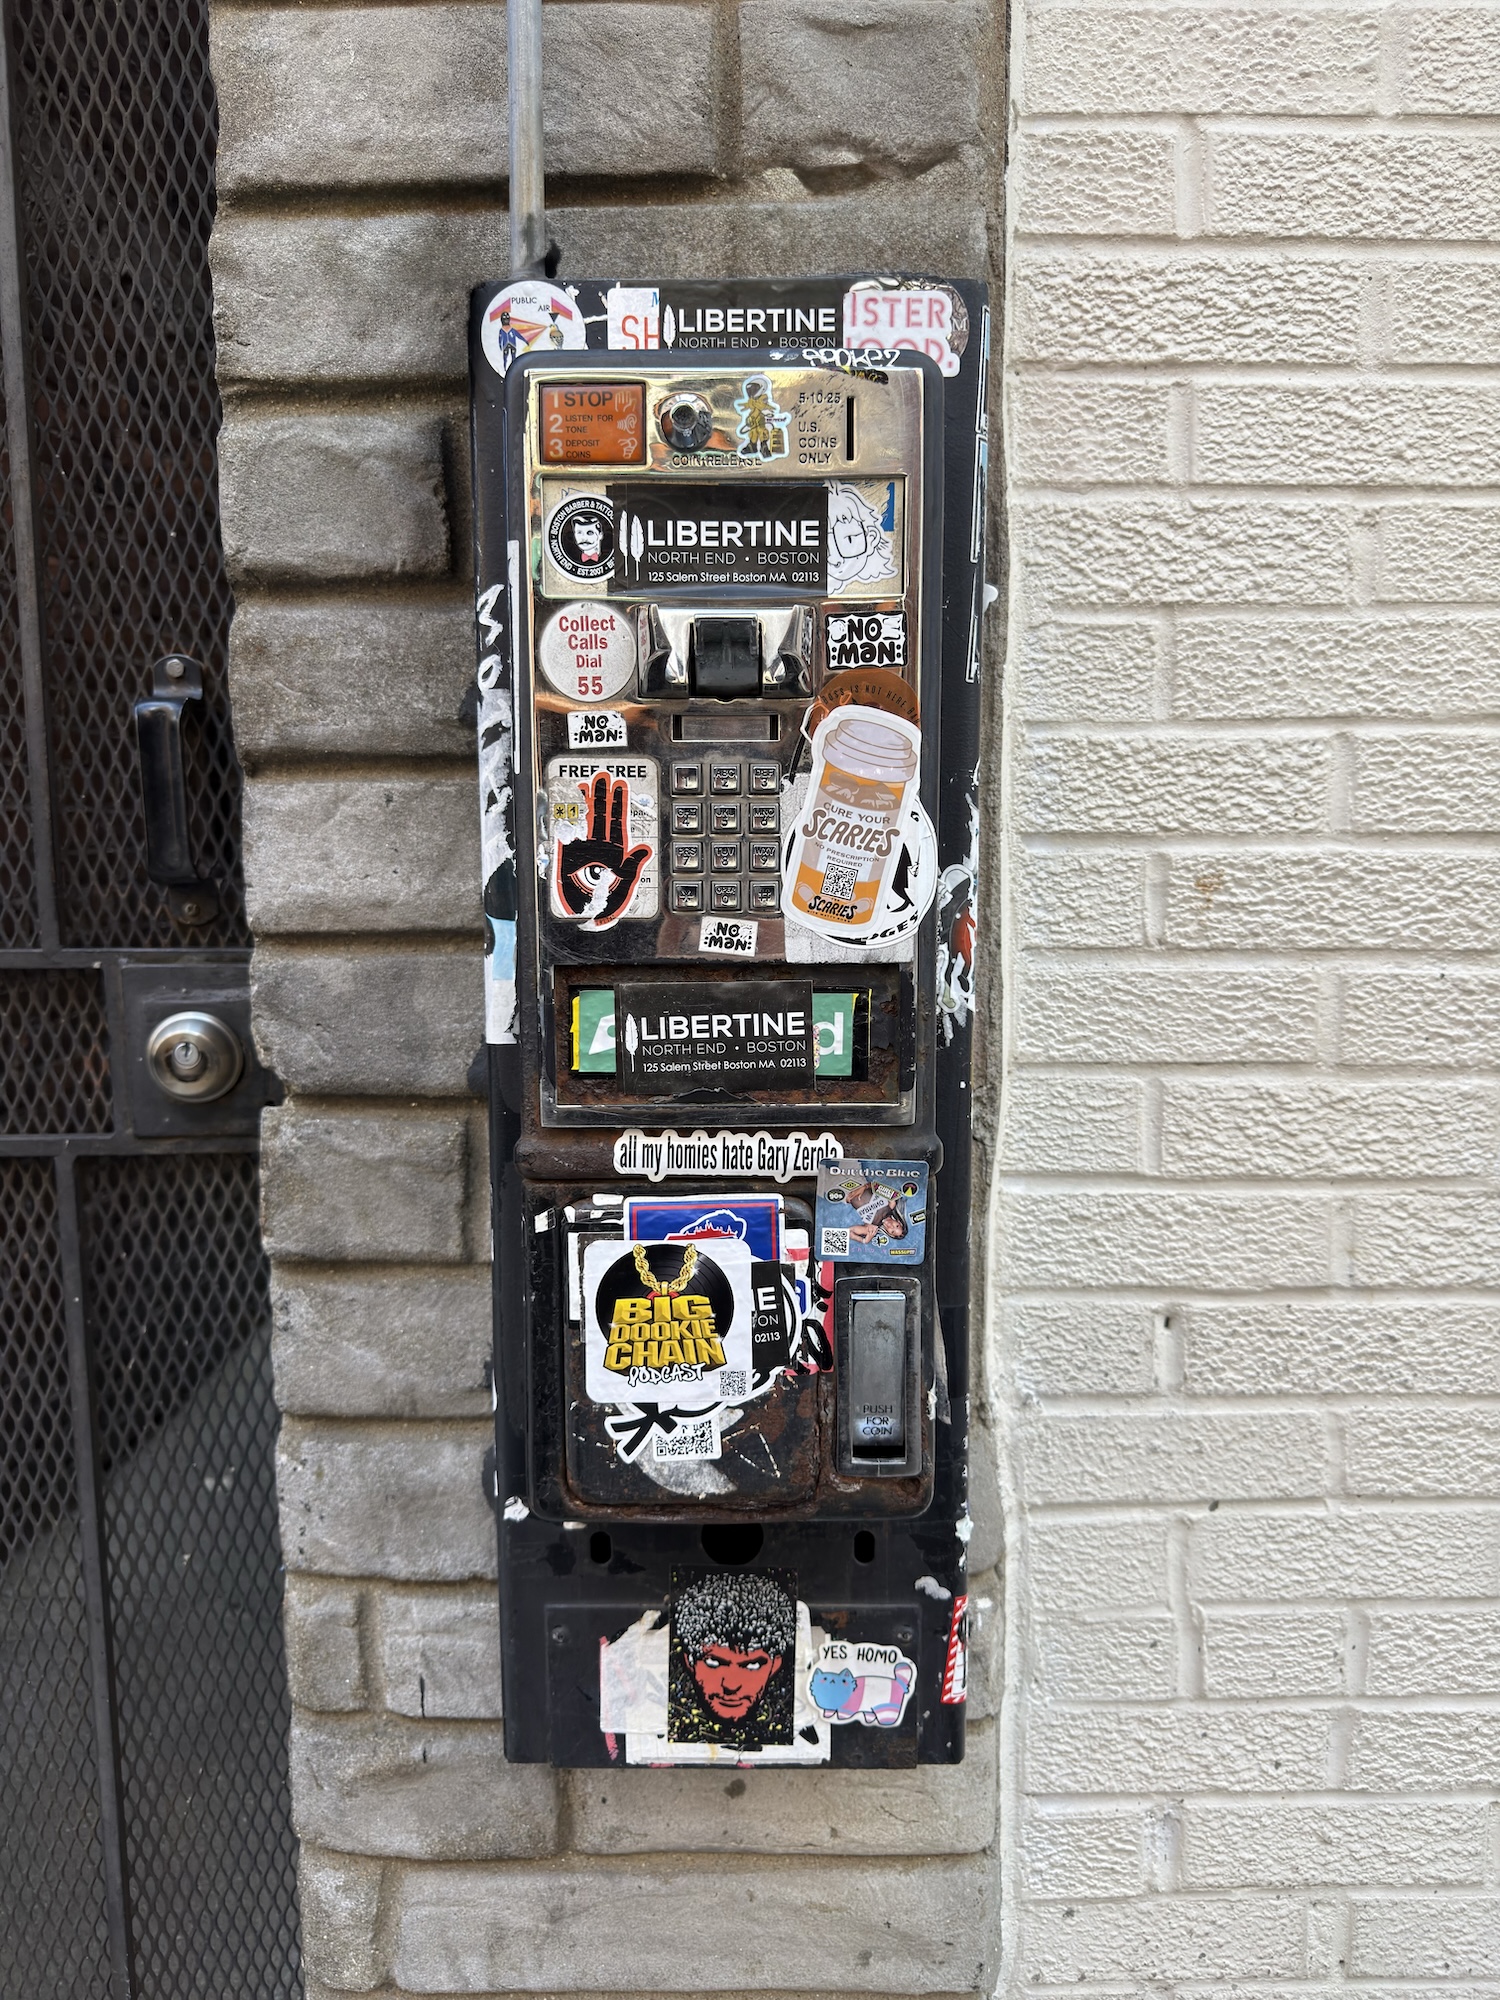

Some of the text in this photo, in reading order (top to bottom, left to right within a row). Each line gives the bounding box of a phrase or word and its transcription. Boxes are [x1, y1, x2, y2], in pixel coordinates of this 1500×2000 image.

[679, 308, 836, 333] LIBERTINE
[679, 337, 836, 348] NORTH END BOSTON
[551, 391, 613, 408] 1 STOP
[549, 414, 563, 433] 2
[798, 421, 821, 432] U.S.
[550, 439, 563, 458] 3
[799, 438, 836, 448] COINS
[672, 454, 762, 466] COIN RELEASE
[799, 453, 831, 464] ONLY
[551, 510, 567, 535] BOSTON
[564, 500, 590, 513] BARBER
[647, 520, 820, 547] LIBERTINE
[648, 552, 820, 564] NORTH END BOSTON
[648, 571, 820, 582] 125 Salem Street Boston MA 02113
[559, 615, 616, 632] Collect
[847, 618, 882, 642] NO
[568, 634, 608, 650] Calls
[576, 655, 602, 668] Dial
[578, 676, 603, 695] 55
[850, 685, 859, 693] IS
[865, 684, 882, 694] NOT
[584, 715, 609, 730] NO
[559, 766, 647, 778] FREE FREE
[823, 802, 891, 825] CURE YOUR
[815, 842, 880, 862] NO PRESCRIPTION
[826, 855, 863, 868] REQUIRED
[716, 922, 741, 938] NO
[641, 1012, 806, 1040] LIBERTINE
[642, 1040, 806, 1056] NORTH END BOSTON
[643, 1058, 807, 1072] 125 Salem Street Boston MA 02113
[620, 1135, 637, 1168] all
[642, 1142, 662, 1176] my
[667, 1136, 717, 1169] homies
[722, 1137, 752, 1169] hate
[757, 1138, 790, 1177] Gary
[613, 1295, 712, 1324] BIG
[609, 1319, 719, 1344] DOOKIE
[754, 1332, 781, 1343] 02113
[603, 1338, 727, 1371] CHAIN
[627, 1361, 706, 1387] PODCAST
[863, 1404, 893, 1413] PUSH
[866, 1416, 889, 1425] FOR
[862, 1426, 892, 1436] COIN
[823, 1645, 897, 1663] YES HOMO
